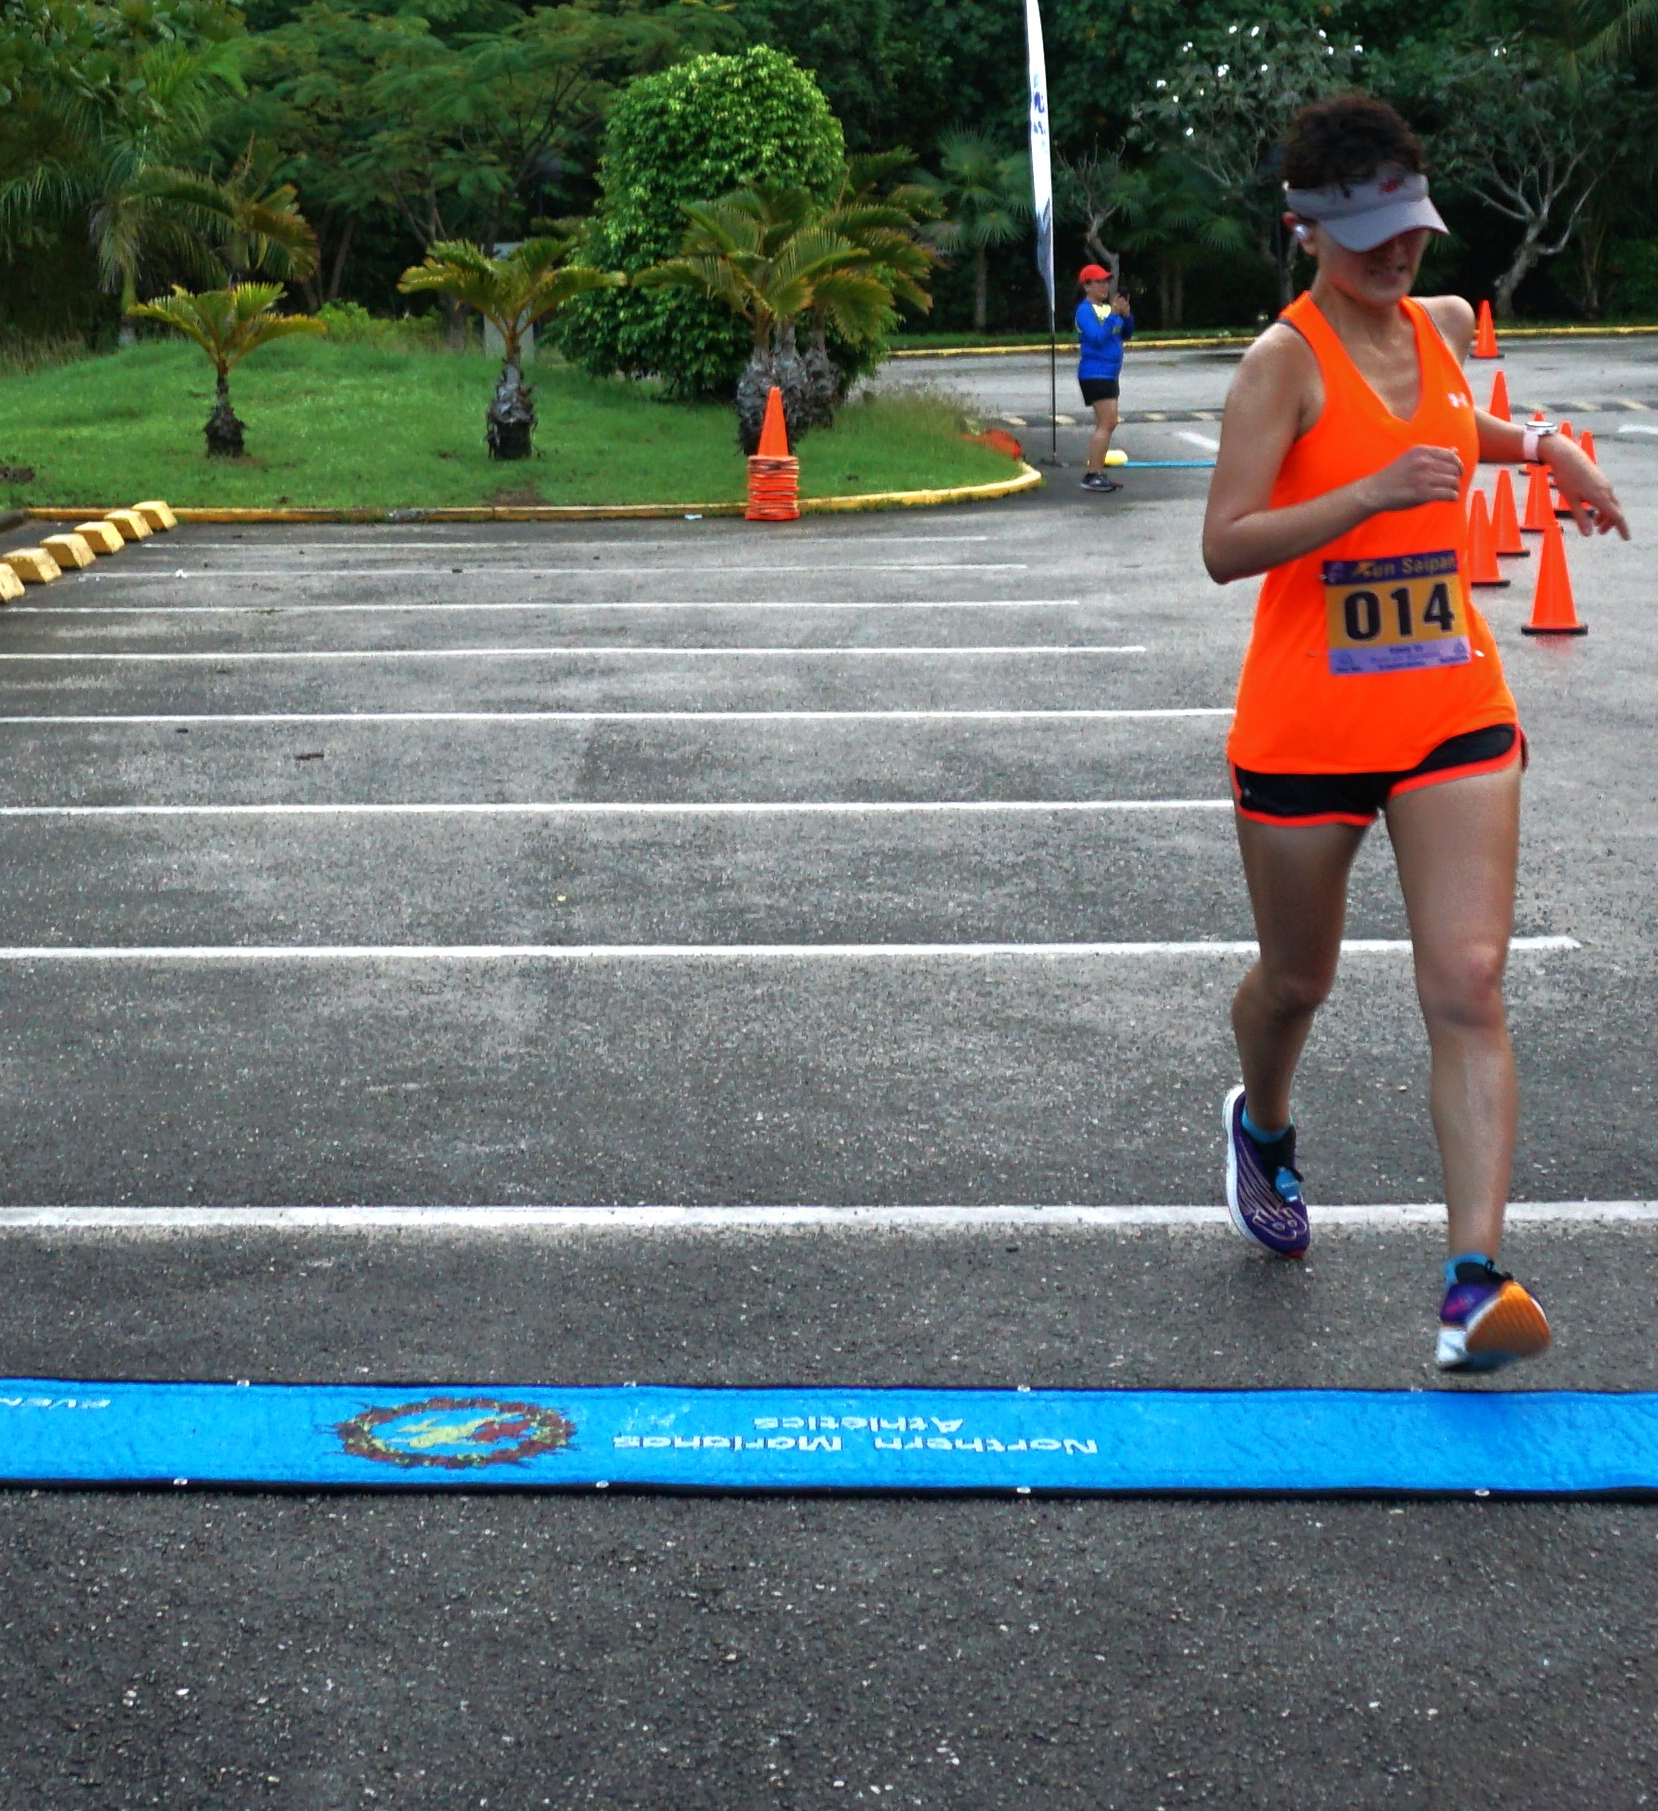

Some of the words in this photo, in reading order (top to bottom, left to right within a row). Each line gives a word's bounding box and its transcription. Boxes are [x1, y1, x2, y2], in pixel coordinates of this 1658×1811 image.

[1344, 583, 1455, 641] 014
[753, 1416, 964, 1433] Athletics
[613, 1435, 842, 1452] Marianas
[874, 1436, 1098, 1455] Northern
